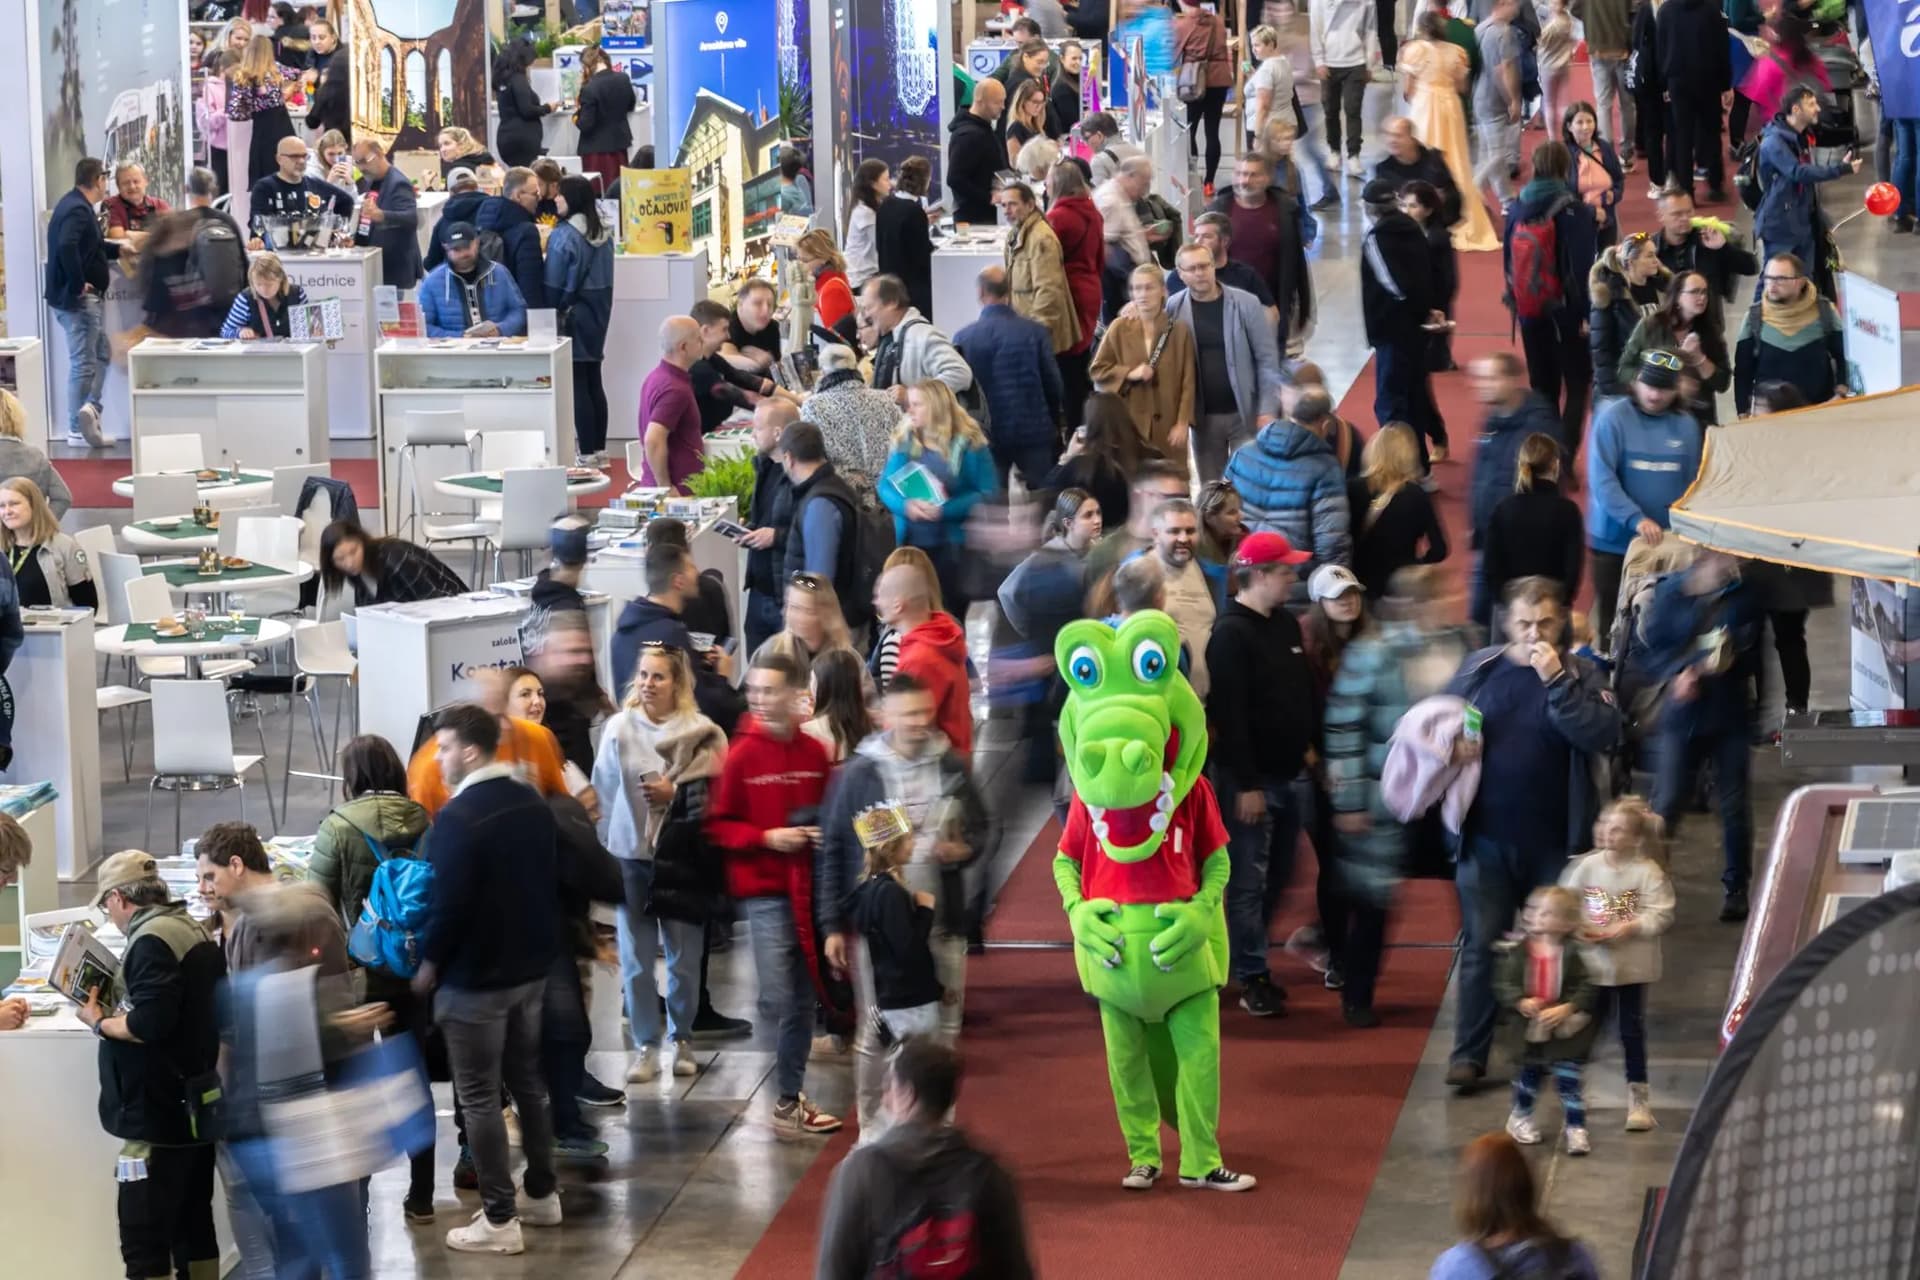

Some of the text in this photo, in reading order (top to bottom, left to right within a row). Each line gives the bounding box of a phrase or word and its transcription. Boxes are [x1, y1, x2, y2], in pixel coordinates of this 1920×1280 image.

[639, 199, 688, 216] OČAJOVAT
[300, 273, 356, 287] Lednice
[492, 636, 518, 647] založe
